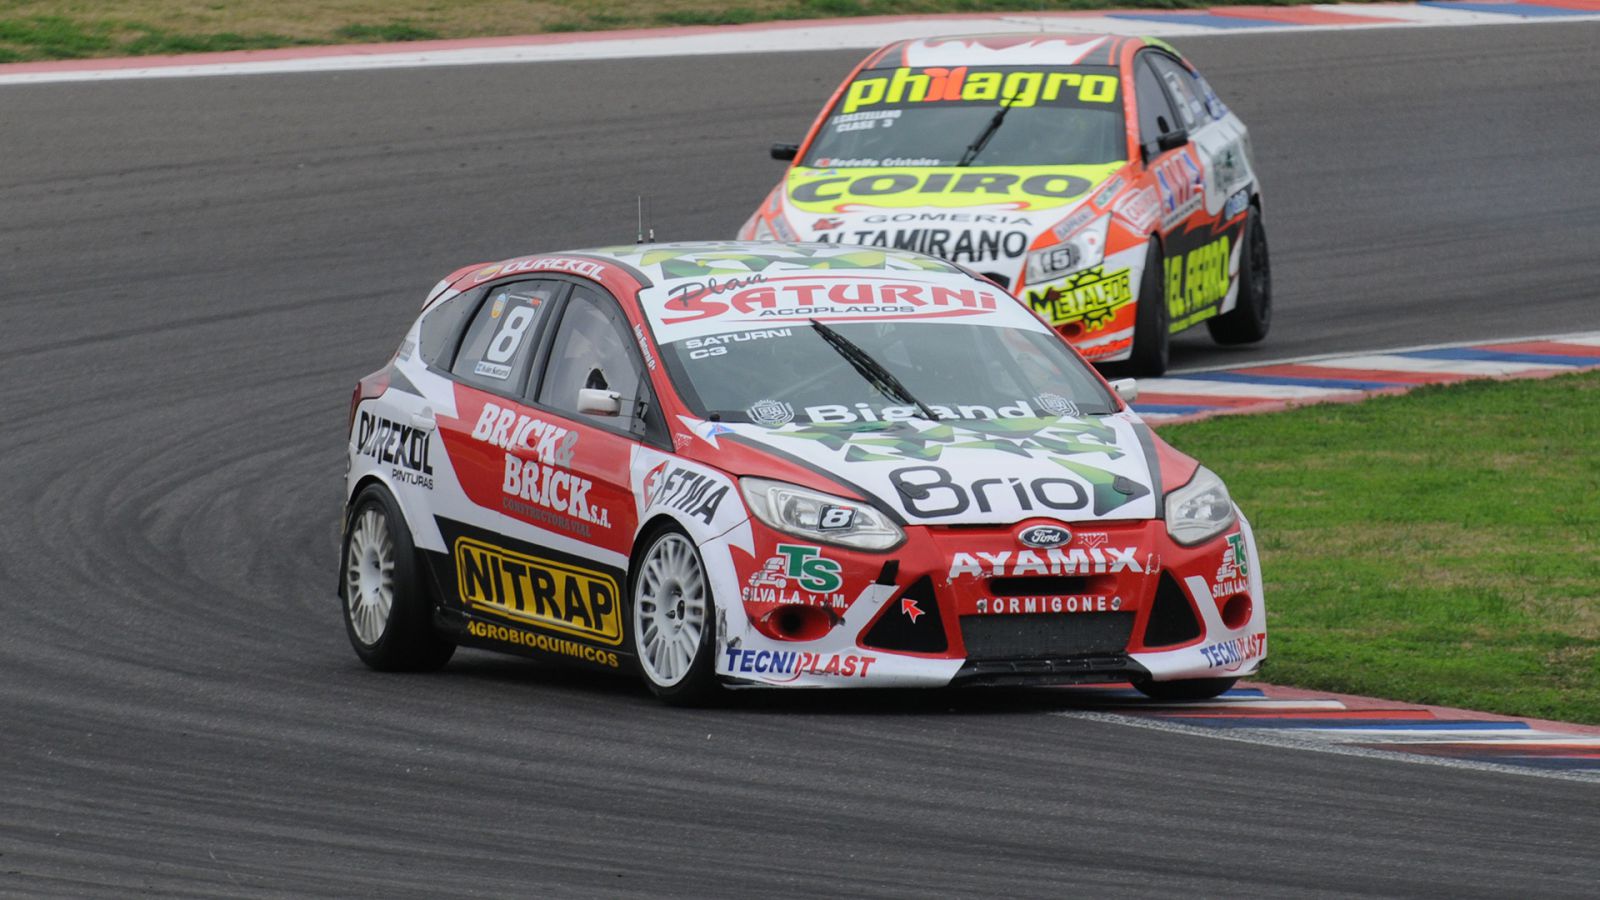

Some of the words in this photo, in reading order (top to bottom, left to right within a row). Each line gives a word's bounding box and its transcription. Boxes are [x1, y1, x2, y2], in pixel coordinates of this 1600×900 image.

[842, 67, 1118, 113] philagro
[836, 120, 876, 133] CLASE
[792, 174, 1093, 203] COIRO
[863, 212, 1032, 225] GOMERIA
[668, 273, 768, 307] Plan
[1027, 275, 1131, 321] METALFOR
[760, 305, 915, 317] ACOPLADOS
[487, 305, 535, 363] 8
[685, 328, 792, 349] SATURNI
[690, 346, 728, 360] C3
[356, 410, 434, 476] DUREKOL
[392, 468, 434, 490] PINTURAS
[502, 452, 592, 522] BRICK
[822, 508, 852, 528] 8
[1031, 529, 1061, 544] Ford
[777, 543, 843, 594] TS
[949, 547, 1143, 578] AYAMIX
[462, 547, 613, 631] NITRAP
[742, 587, 776, 603] SILVA
[1212, 580, 1235, 598] SILVA
[467, 620, 619, 667] AGROBIOQUIMICOS
[1200, 633, 1265, 668] TECNIPLAST
[725, 648, 876, 678] TECNIPLAST
